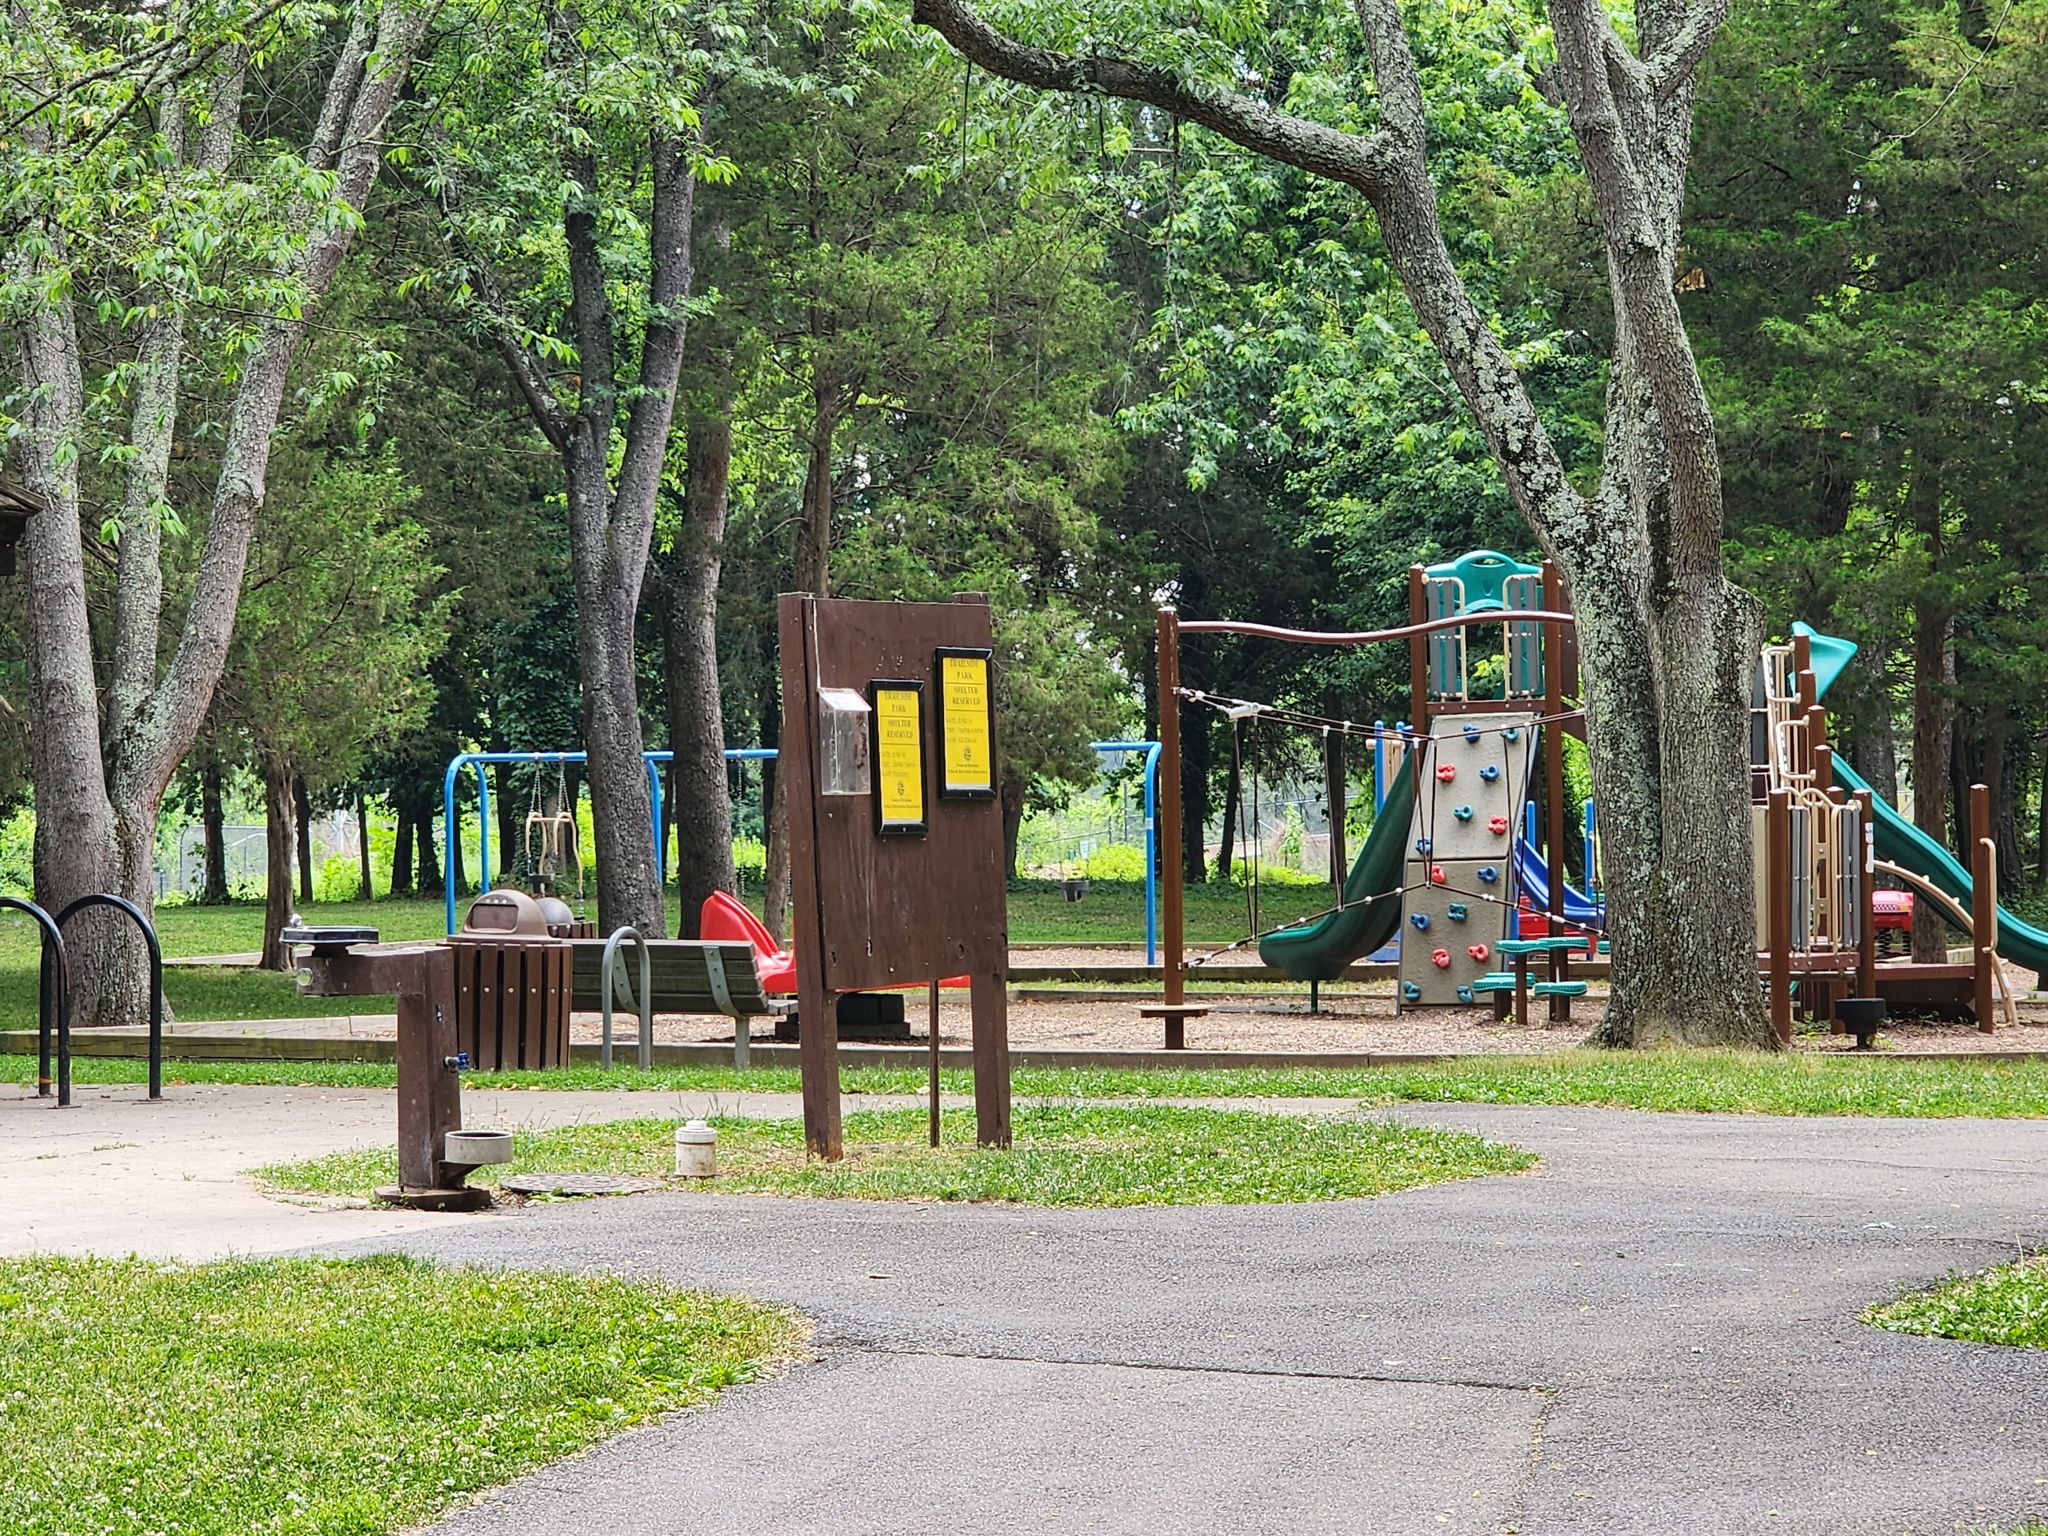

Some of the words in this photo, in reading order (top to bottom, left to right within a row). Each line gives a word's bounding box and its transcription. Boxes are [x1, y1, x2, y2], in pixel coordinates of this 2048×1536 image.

[957, 671, 973, 680] PARK
[953, 686, 979, 694] SHELTER
[952, 697, 981, 705] RESERVED
[891, 704, 907, 712] PARK
[888, 719, 912, 727] SHELTER
[886, 730, 914, 738] RESERVED
